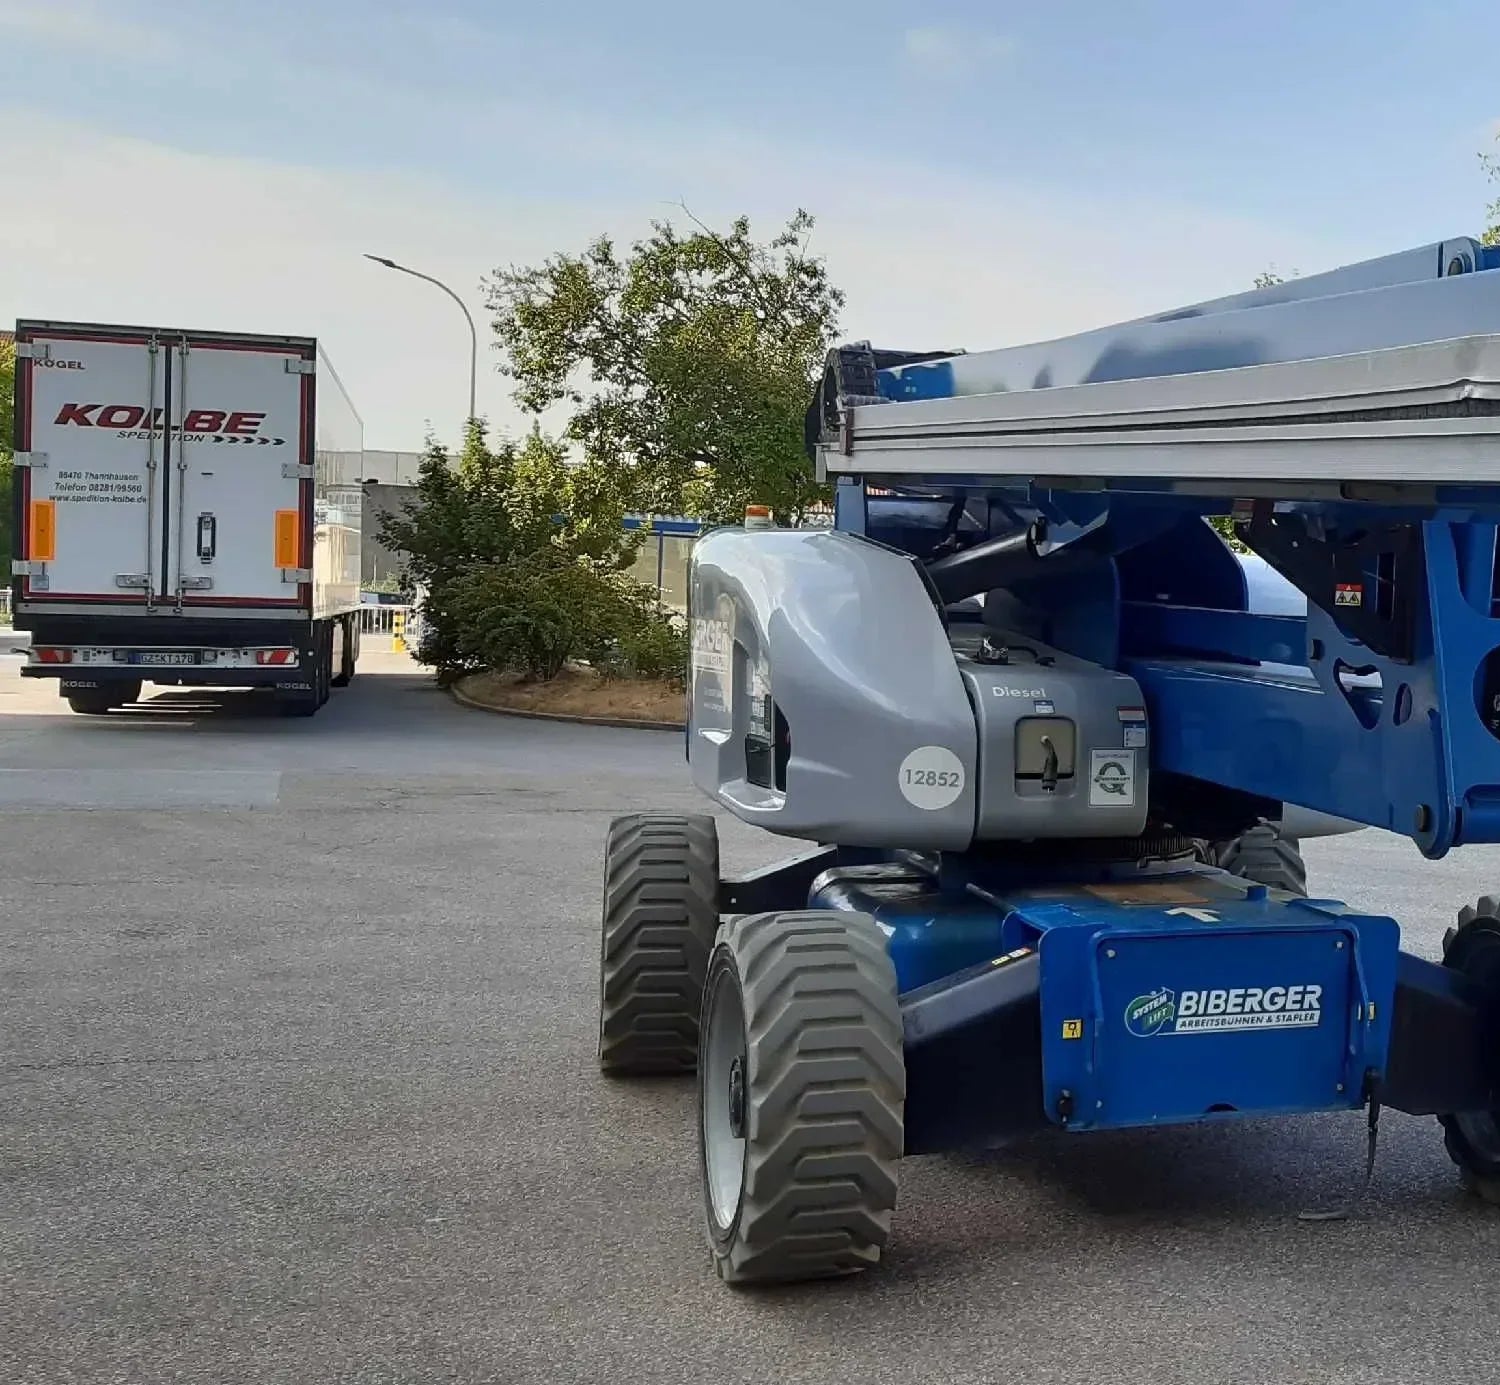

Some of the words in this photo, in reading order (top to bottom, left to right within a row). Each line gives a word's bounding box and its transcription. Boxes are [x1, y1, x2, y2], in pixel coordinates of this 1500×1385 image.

[54, 403, 267, 435] KOLBE
[117, 430, 206, 442] SPEDITION
[55, 482, 87, 491] Telefon
[992, 685, 1047, 698] Diesel
[905, 768, 960, 788] 12852
[1132, 993, 1168, 1020] SYSTEM
[1177, 984, 1323, 1017] BIBERGER
[1275, 1013, 1316, 1024] STAPLER
